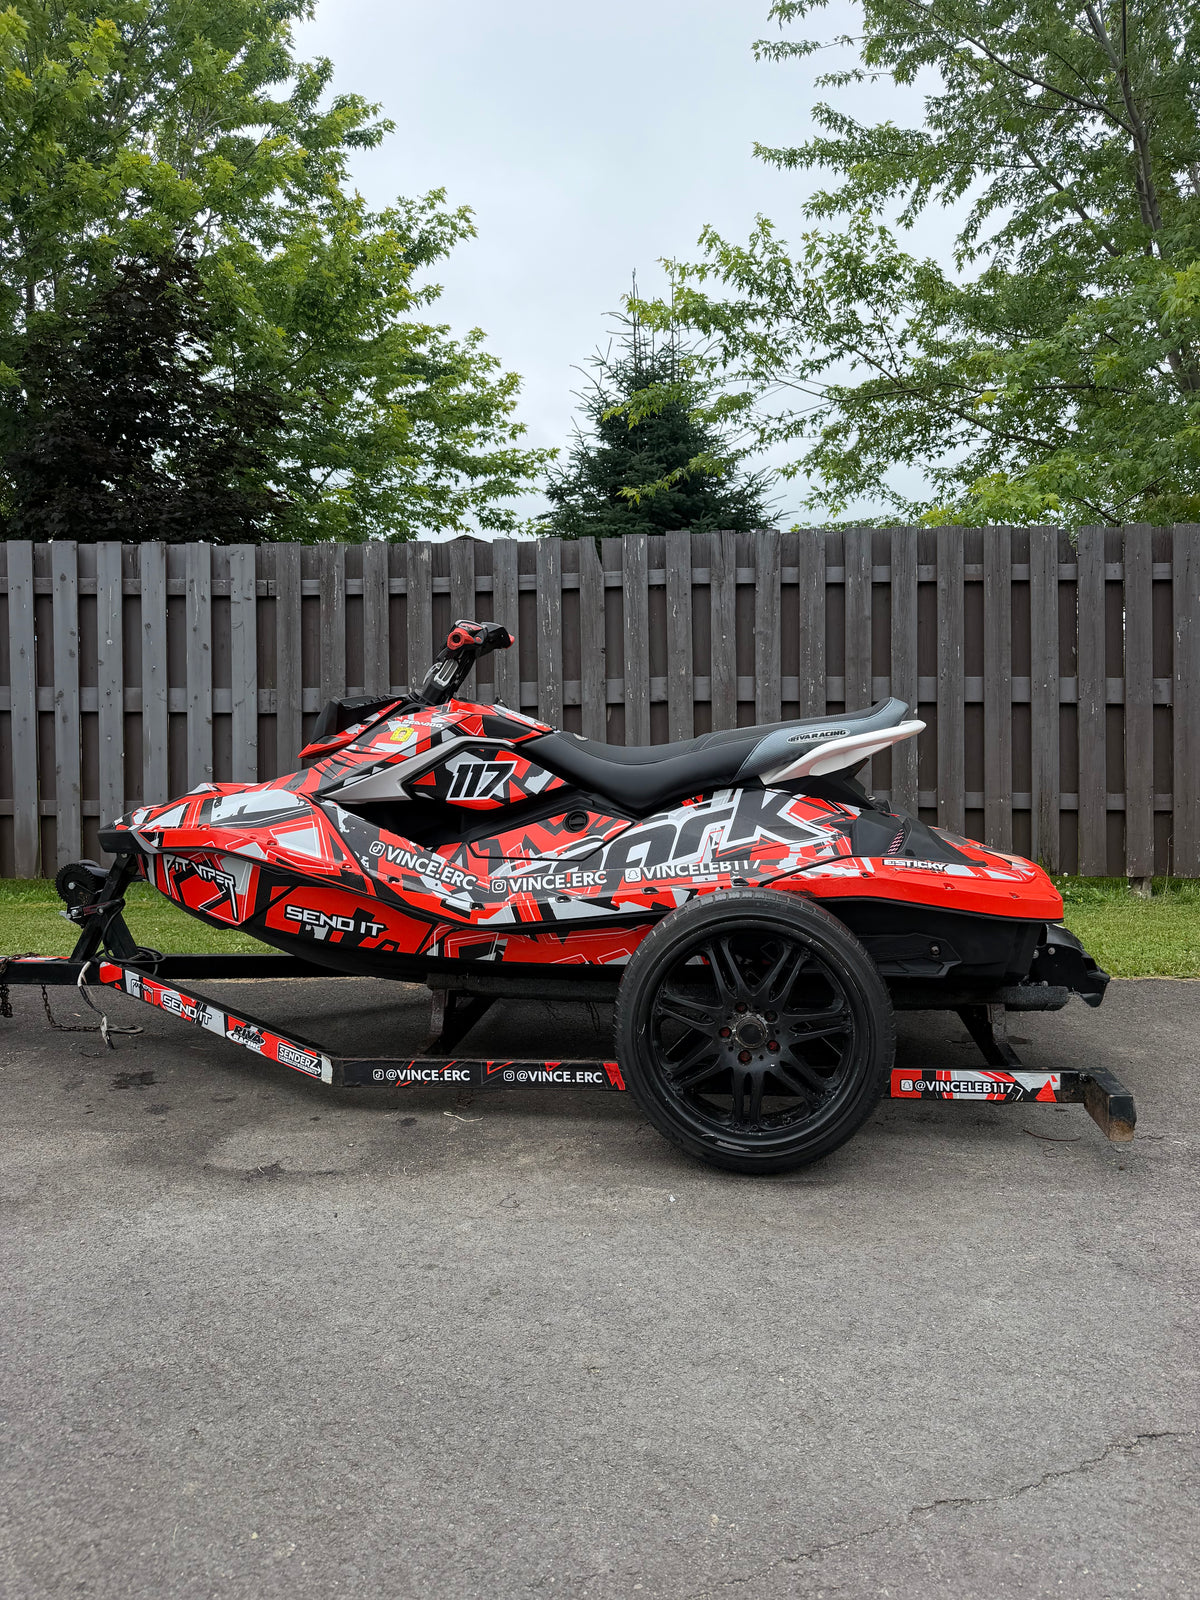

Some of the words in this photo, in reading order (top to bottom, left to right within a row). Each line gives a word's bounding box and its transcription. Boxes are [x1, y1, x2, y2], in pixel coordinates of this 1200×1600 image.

[811, 730, 846, 738] RACING
[448, 761, 516, 799] 117
[386, 845, 477, 890] VINCE.ERC
[509, 870, 608, 892] VINCE.ERC
[286, 905, 355, 932] SEND
[360, 921, 384, 936] IT
[163, 995, 198, 1019] SEND
[199, 1011, 212, 1025] IT
[233, 1034, 261, 1050] RACING
[234, 1025, 262, 1044] RIVA
[279, 1045, 320, 1072] SENDERZ
[386, 1069, 471, 1081] @VINCE.ERC
[517, 1070, 603, 1083] @VINCE.ERC
[914, 1080, 1014, 1094] @VINCELEB117
